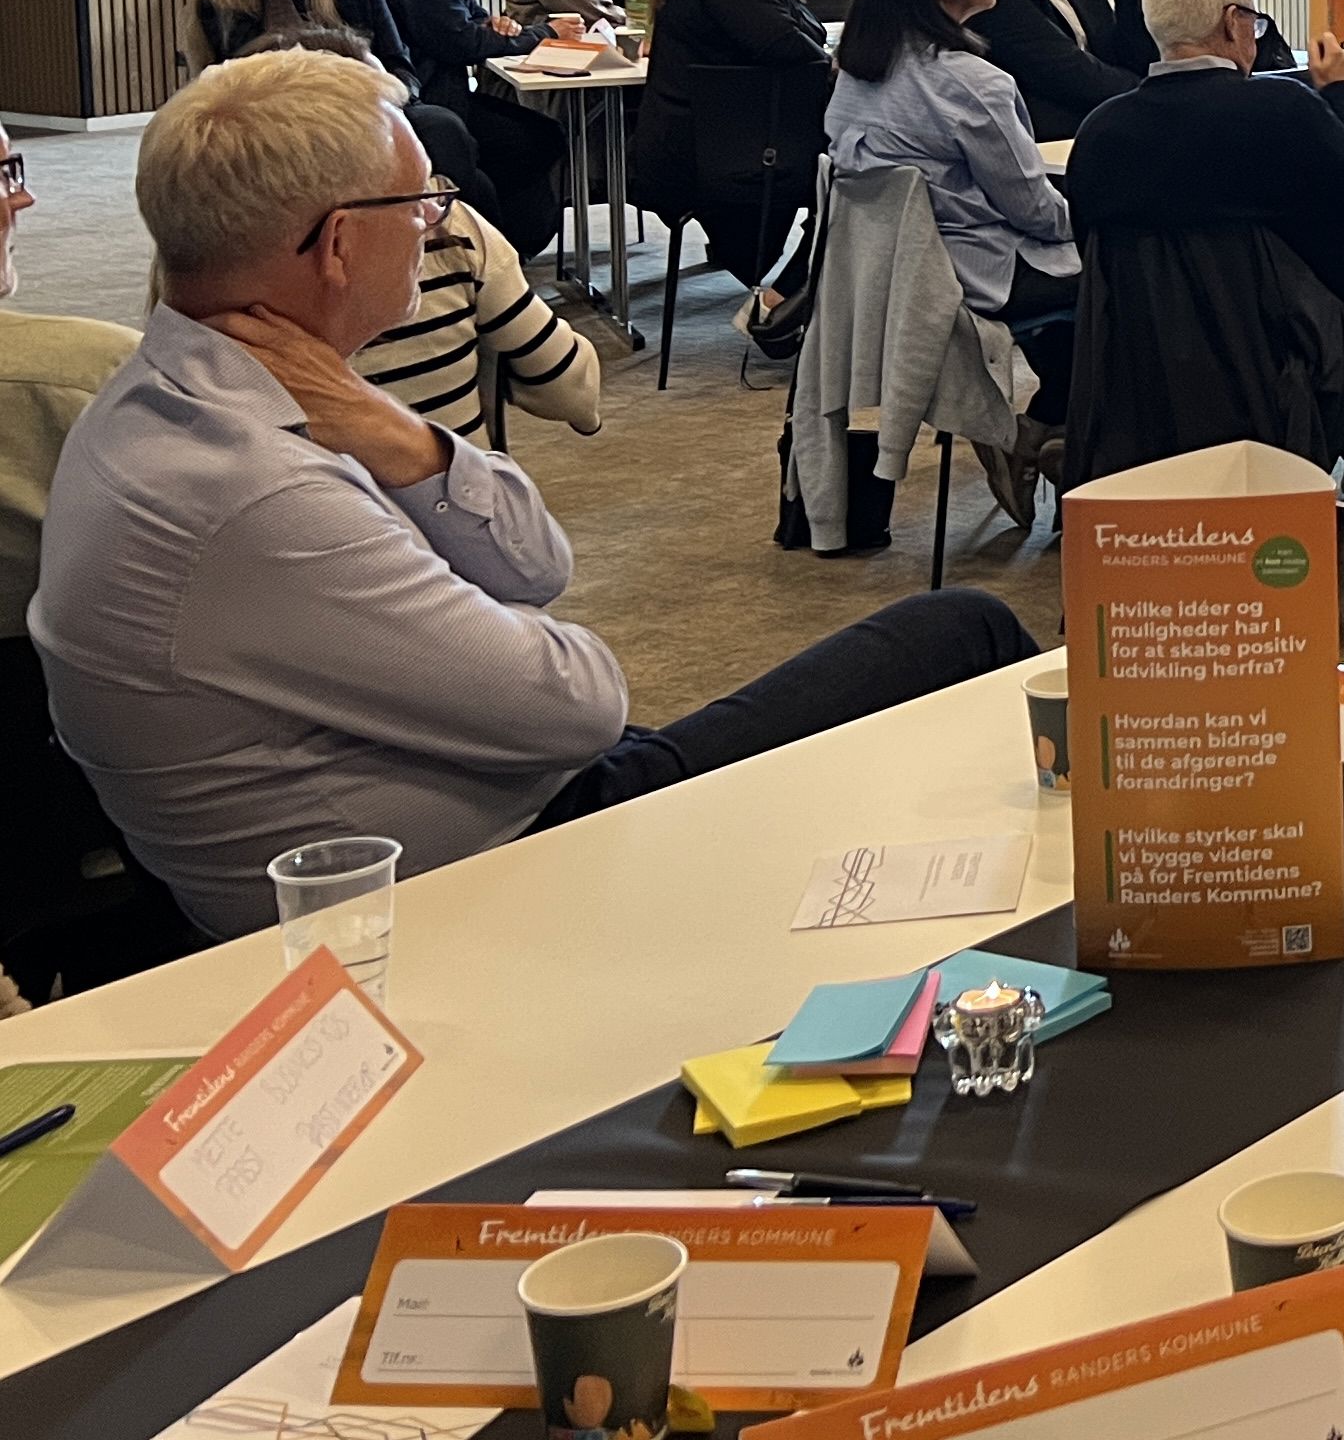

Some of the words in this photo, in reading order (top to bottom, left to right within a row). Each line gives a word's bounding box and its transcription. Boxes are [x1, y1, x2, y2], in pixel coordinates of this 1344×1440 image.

[1095, 521, 1255, 549] Fremtidens
[1103, 555, 1169, 566] RANDERS
[1174, 552, 1247, 565] KOMMUNE
[1110, 601, 1172, 618] Hvilke
[1179, 599, 1231, 617] idéer
[1237, 602, 1263, 617] og
[1111, 622, 1228, 641] muligheder
[1235, 620, 1269, 635] har
[1111, 642, 1139, 658] for
[1145, 643, 1164, 658] at
[1170, 640, 1231, 657] skabe
[1238, 636, 1306, 657] positiv
[1113, 662, 1206, 681] udvikling
[1213, 659, 1285, 677] herfra?
[1115, 714, 1198, 729] Hvordan
[1206, 713, 1242, 727] kan
[1249, 708, 1266, 725] vi
[1115, 735, 1201, 749] sammen
[1209, 731, 1286, 749] bidrage
[1116, 754, 1134, 770] til
[1141, 754, 1165, 769] de
[1171, 751, 1277, 772] afgørende
[1117, 772, 1255, 792] forandringer?
[1119, 829, 1180, 844] Hvilke
[1186, 826, 1257, 846] styrker
[1264, 822, 1303, 839] skal
[1120, 848, 1135, 863] vi
[1142, 846, 1203, 867] bygge
[1209, 847, 1272, 861] videre
[1120, 868, 1143, 886] på
[1150, 868, 1177, 883] for
[1183, 865, 1300, 883] Fremtidens
[1121, 888, 1201, 904] Randers
[1208, 881, 1322, 903] Kommune?
[480, 1219, 600, 1245] Fremtid
[738, 1229, 836, 1246] KOMMUNE
[860, 1374, 1038, 1440] Fremtidens
[1050, 1344, 1151, 1388] RANDERS
[1159, 1315, 1263, 1361] KOMMUNE
